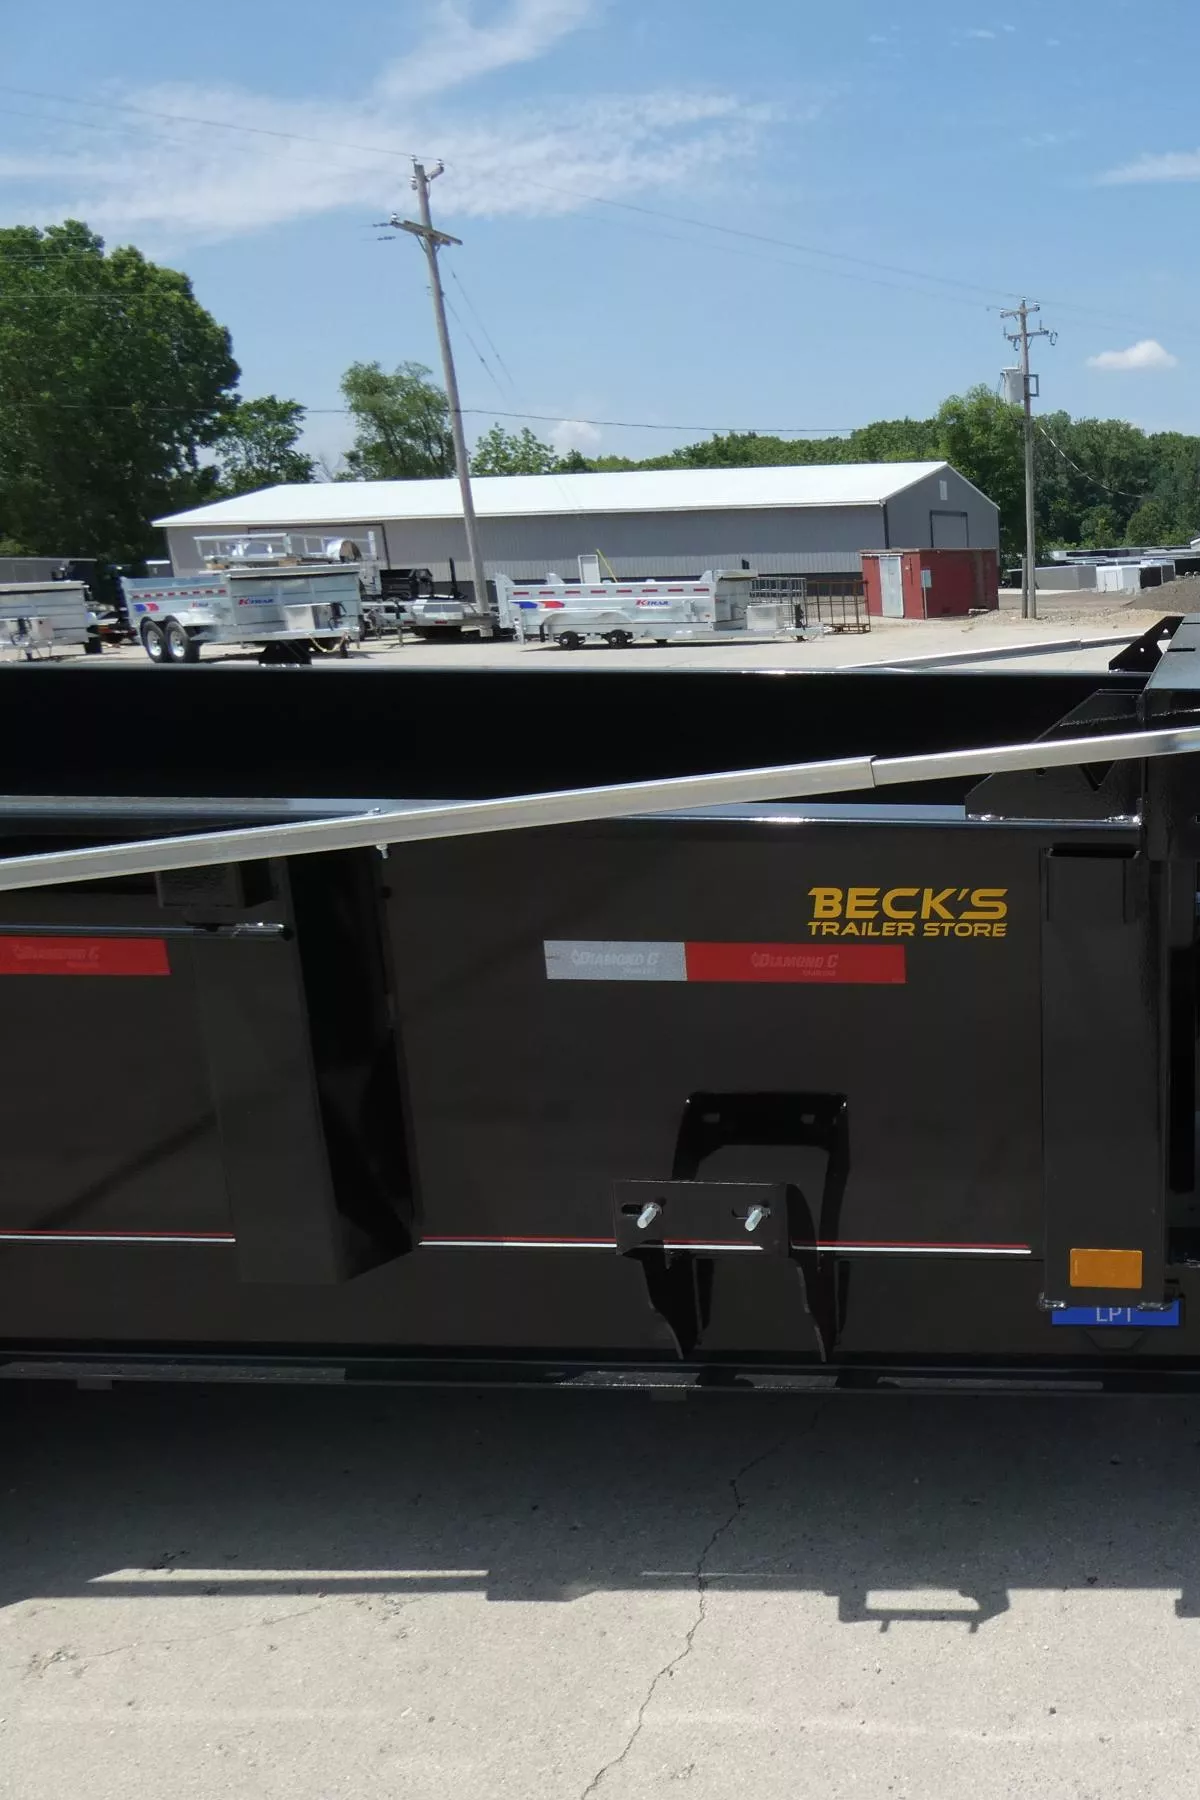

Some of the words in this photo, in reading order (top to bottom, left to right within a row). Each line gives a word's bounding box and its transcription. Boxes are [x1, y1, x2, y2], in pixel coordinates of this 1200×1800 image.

[808, 887, 1008, 919] BECK'S
[808, 922, 915, 937] TRAILER
[923, 922, 1007, 937] STORE
